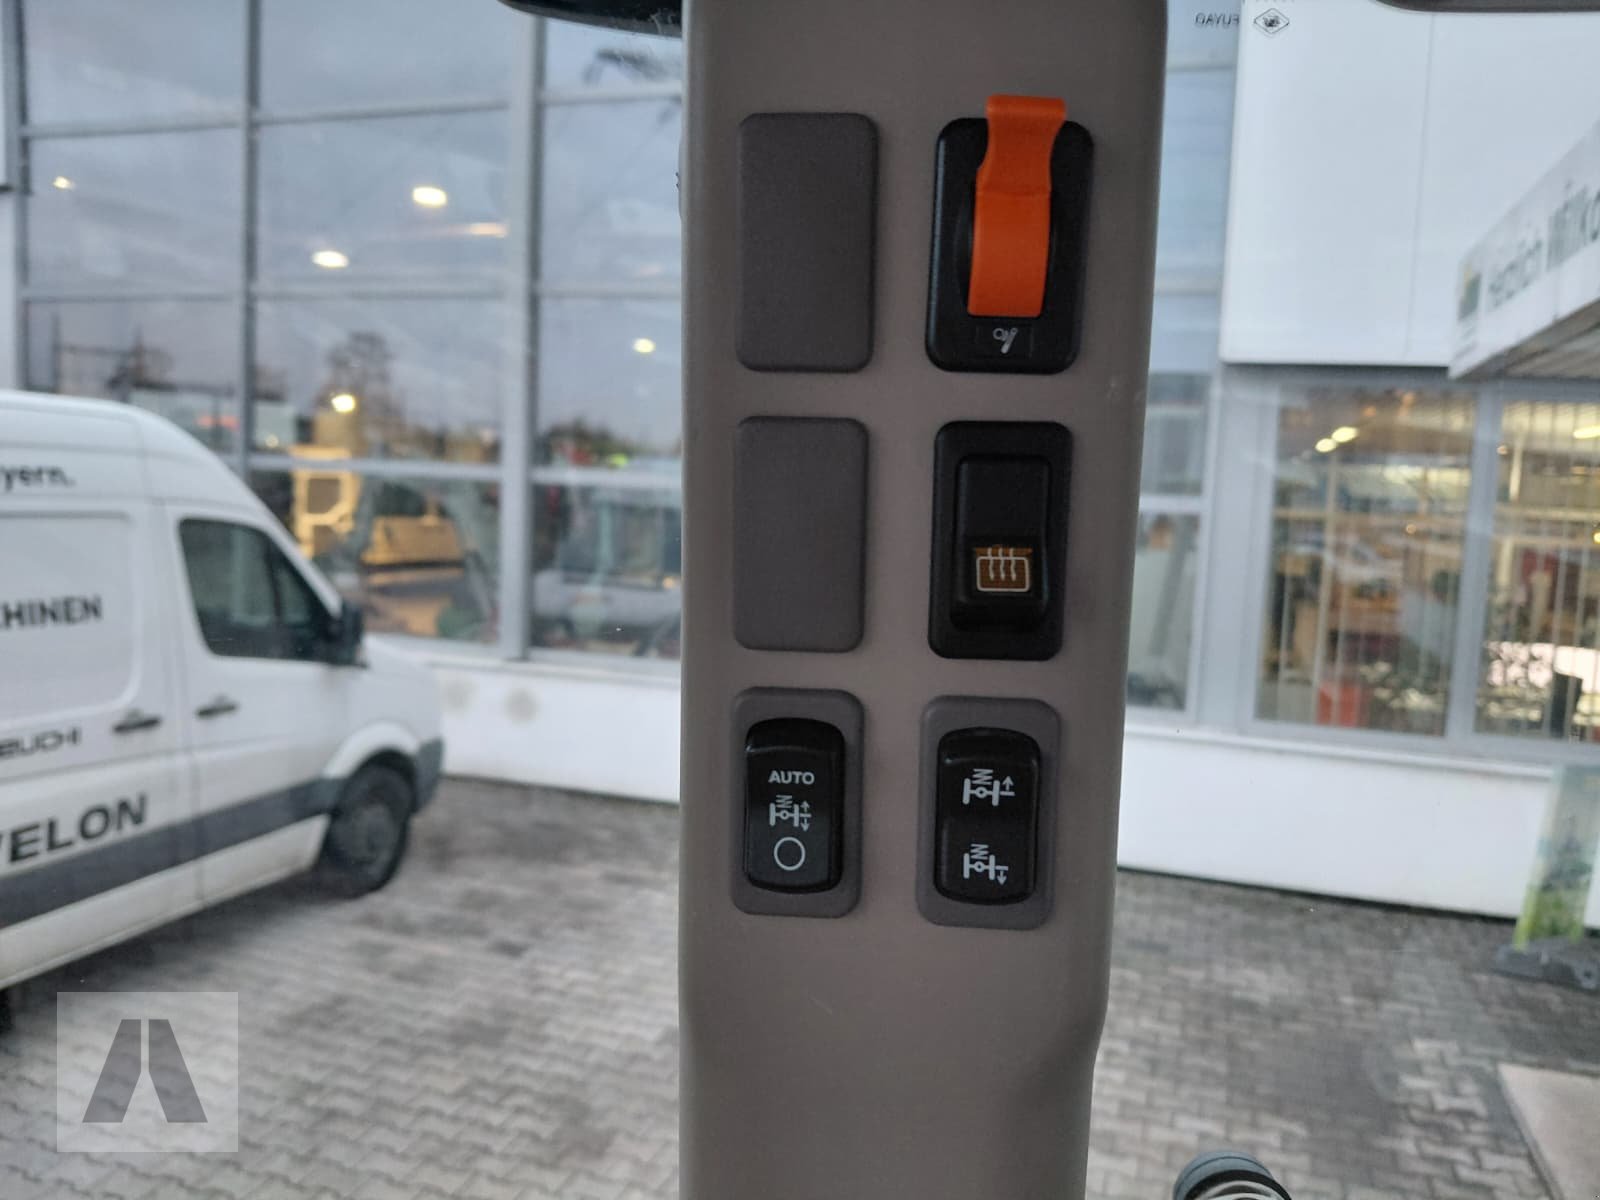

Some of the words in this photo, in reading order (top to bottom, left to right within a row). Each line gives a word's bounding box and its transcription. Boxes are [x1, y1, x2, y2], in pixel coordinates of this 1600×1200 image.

[0, 595, 103, 630] HINEN
[768, 770, 815, 785] AUTO
[0, 793, 148, 864] ELON
